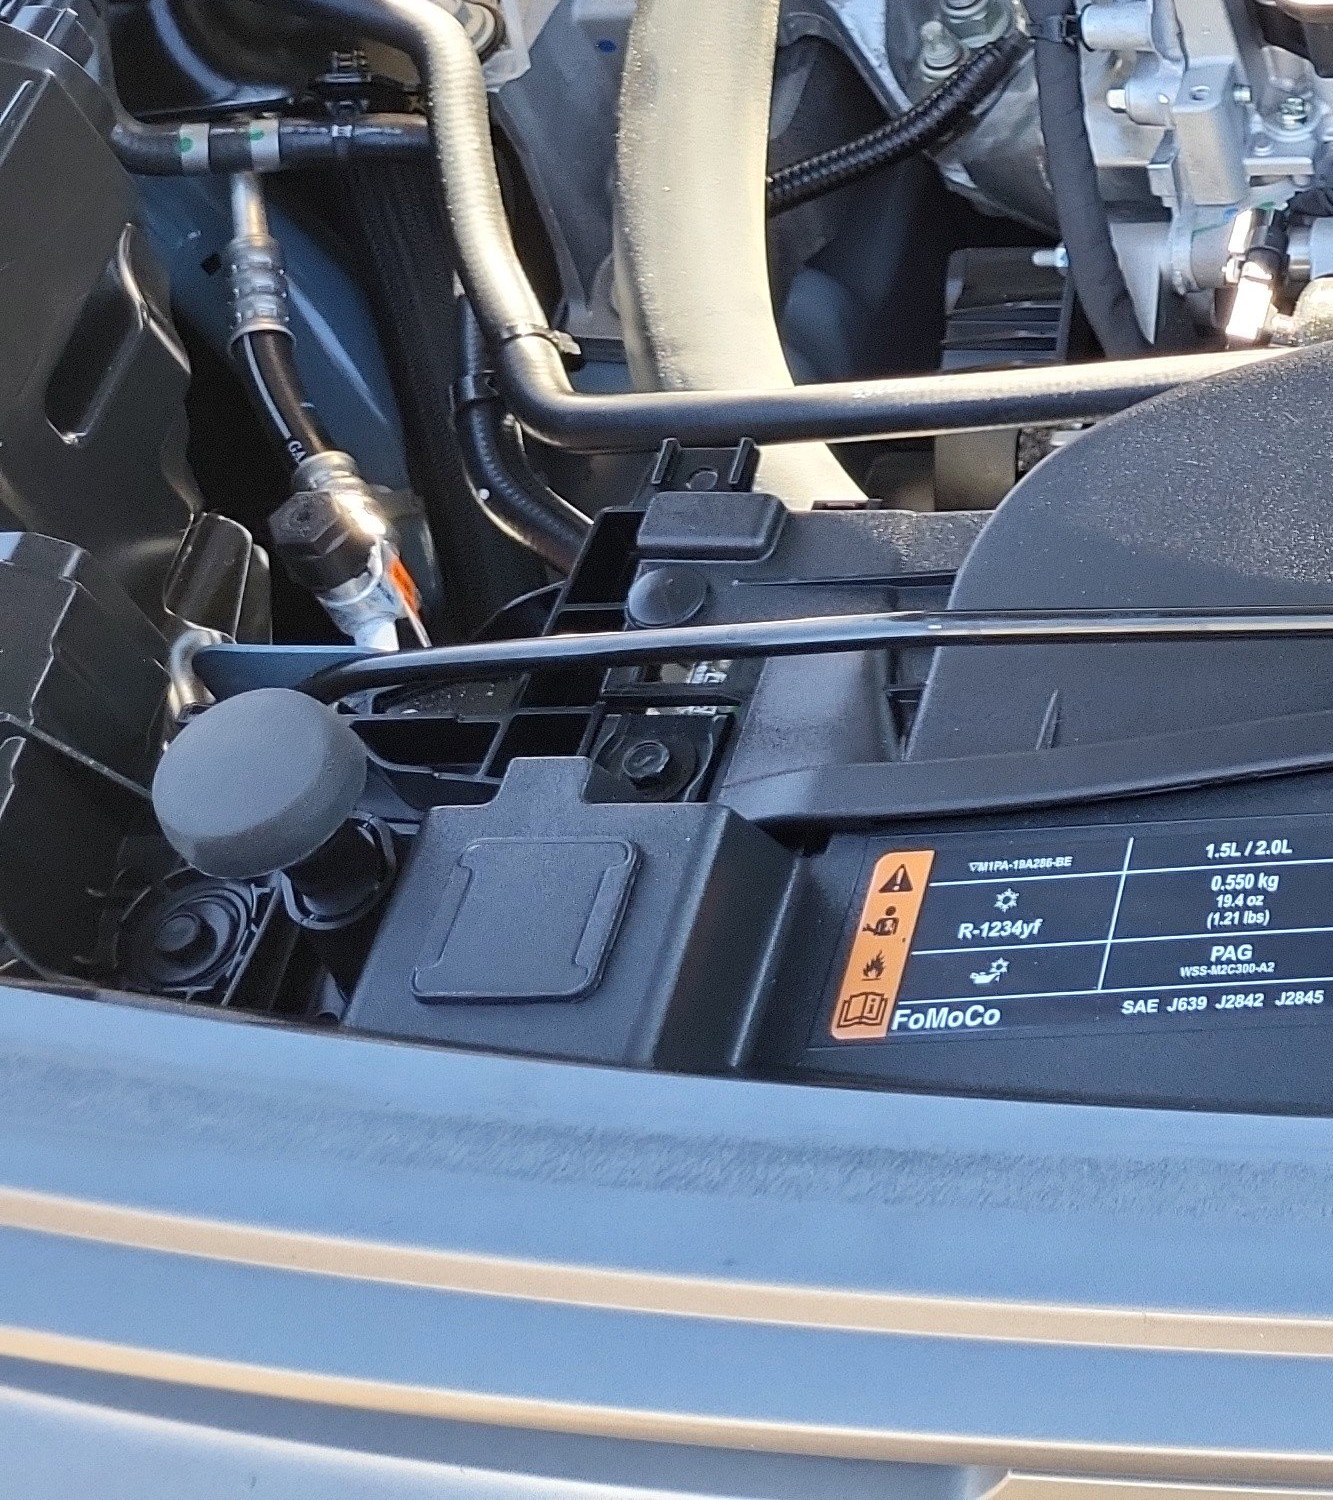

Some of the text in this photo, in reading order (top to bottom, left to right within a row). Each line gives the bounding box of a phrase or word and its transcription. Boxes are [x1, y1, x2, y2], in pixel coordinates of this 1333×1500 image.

[1205, 838, 1293, 860] 1.5L / 2.0L
[1210, 872, 1280, 893] 0.550 kg
[1216, 893, 1265, 908] 19.4 oz
[957, 917, 1042, 942] R-1234yf
[1206, 908, 1271, 931] (1.21 lbs)
[1209, 943, 1254, 963] PAG
[1179, 961, 1276, 979] WSS-M2C300-A2
[1120, 990, 1325, 1015] SAE J639 J2842 J2845
[890, 1004, 1002, 1032] FoMoCo
